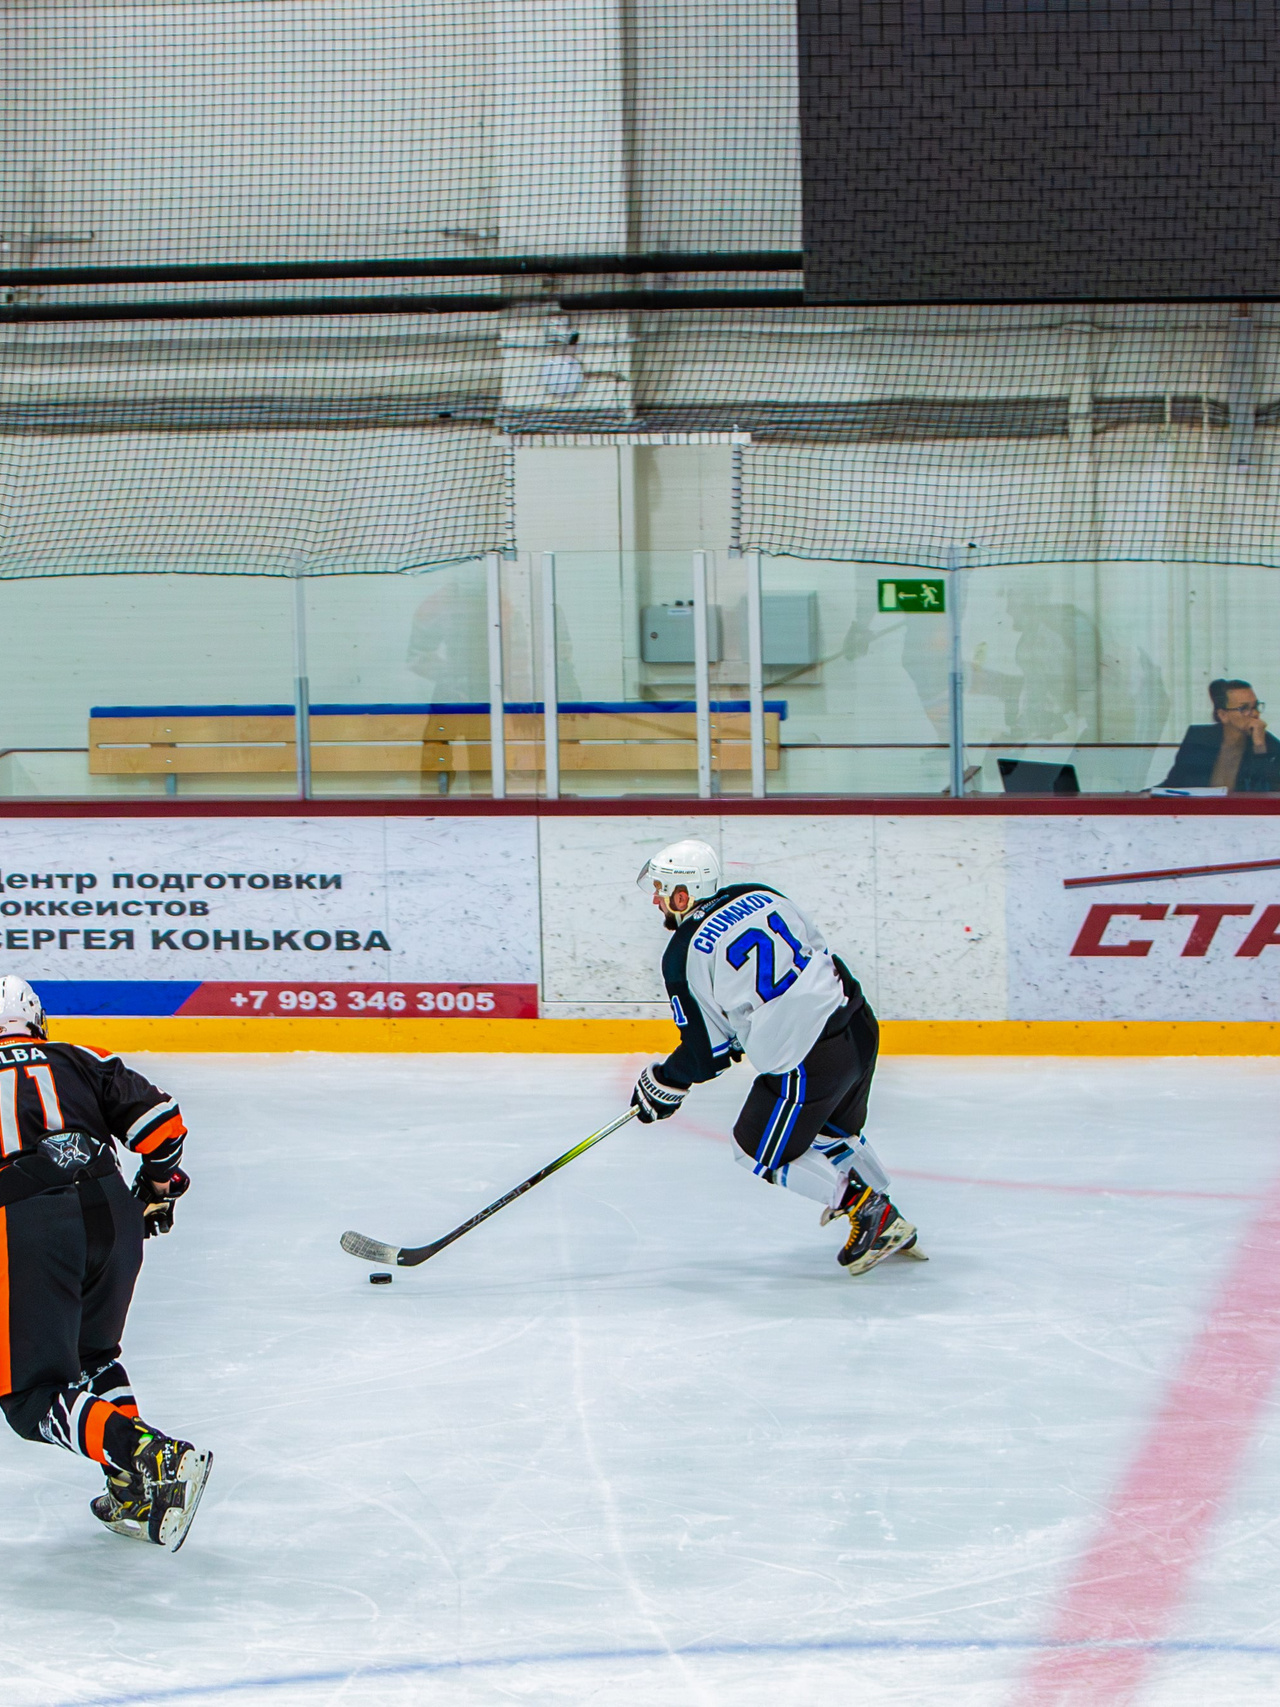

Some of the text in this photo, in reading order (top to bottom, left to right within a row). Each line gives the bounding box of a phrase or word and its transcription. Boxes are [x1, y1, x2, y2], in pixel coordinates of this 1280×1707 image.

[112, 872, 342, 893] подготовки
[693, 892, 774, 955] CHUMAKOV
[151, 929, 392, 951] КОНЬКОВА
[726, 910, 812, 1003] 21
[230, 990, 496, 1012] +7 993 346 3005
